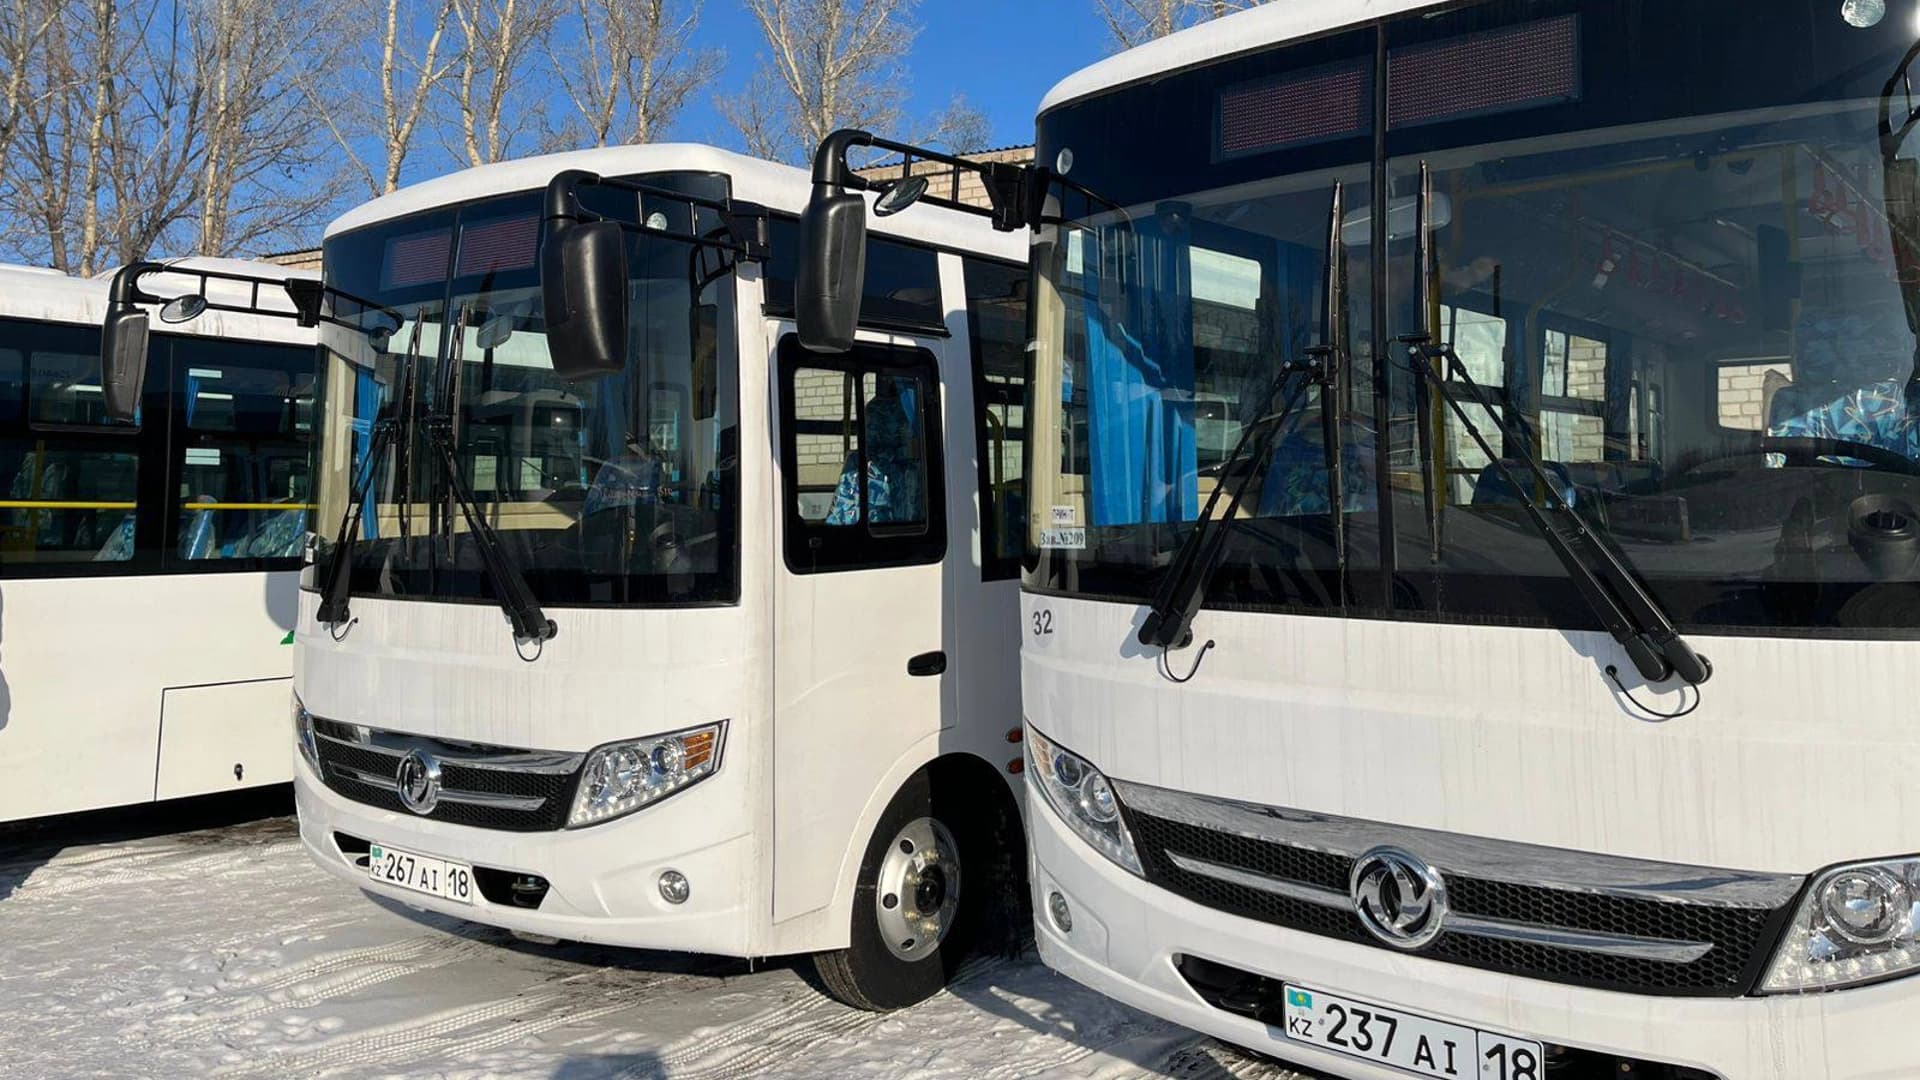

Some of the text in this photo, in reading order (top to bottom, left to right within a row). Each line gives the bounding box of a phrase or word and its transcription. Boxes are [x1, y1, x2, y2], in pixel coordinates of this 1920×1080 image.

[1032, 609, 1053, 635] 32
[386, 853, 469, 897] 267 AI 18
[1288, 1015, 1313, 1038] KZ
[1325, 1003, 1537, 1080] 237 AI 18
